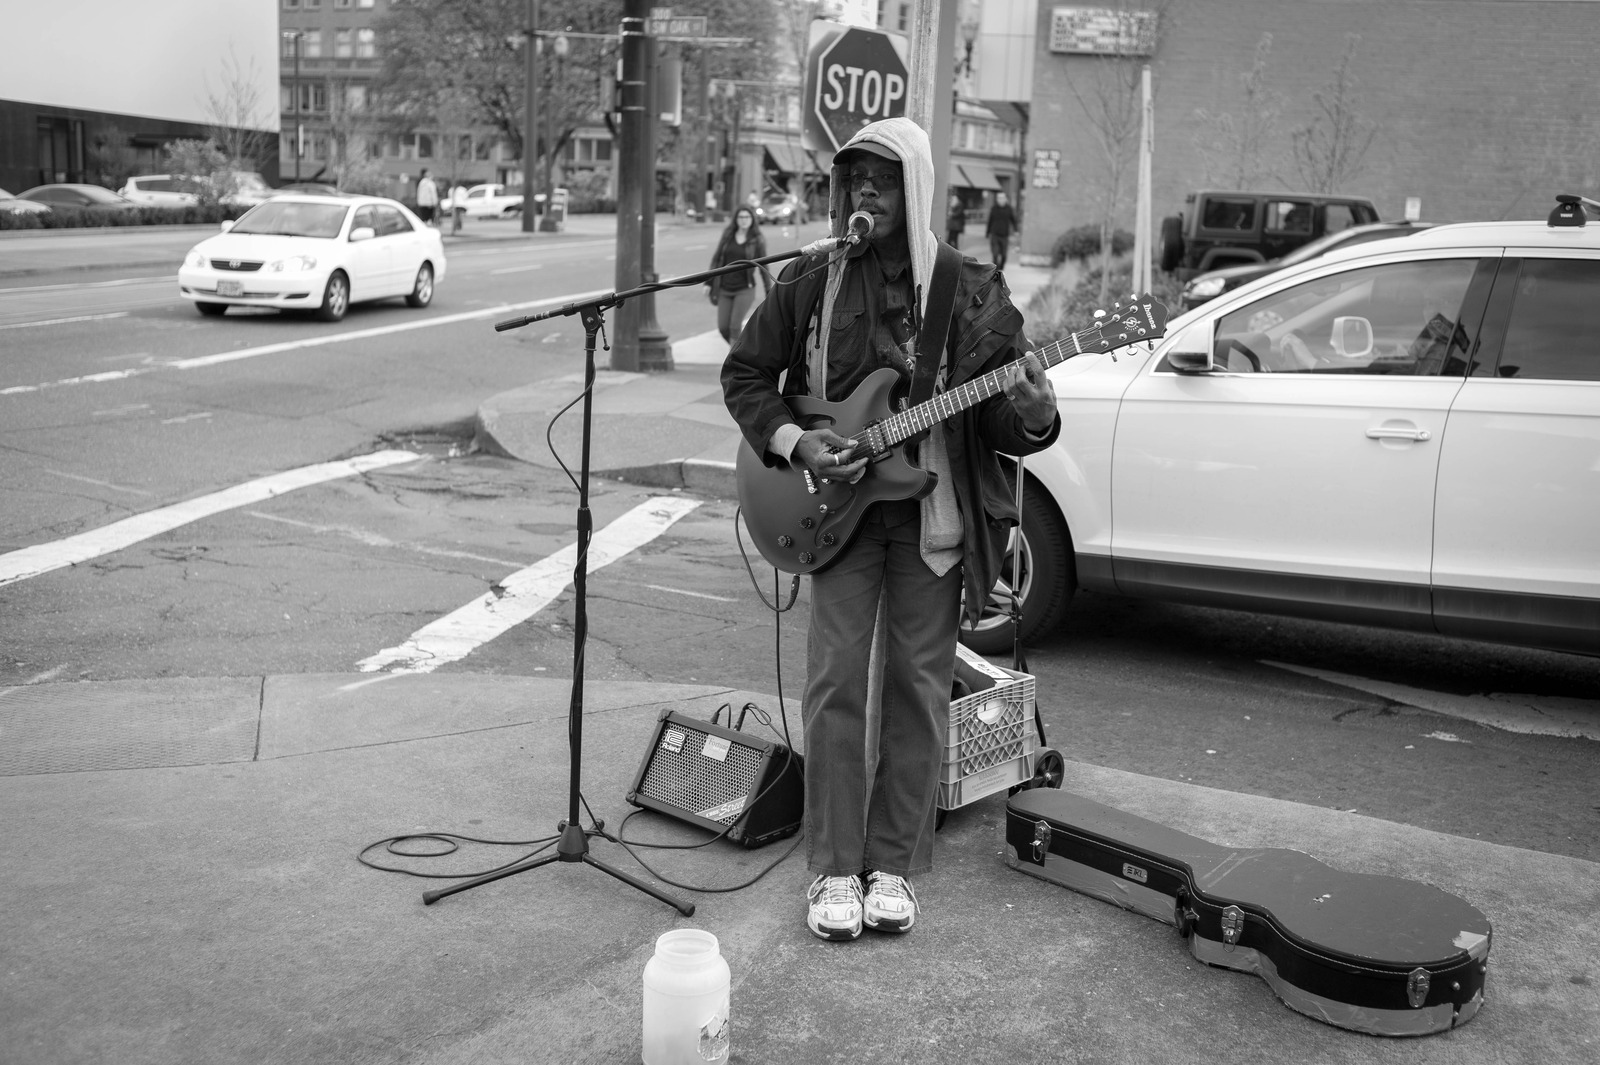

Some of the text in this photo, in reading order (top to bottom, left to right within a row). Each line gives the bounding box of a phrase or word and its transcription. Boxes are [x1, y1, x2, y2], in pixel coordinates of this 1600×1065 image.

[652, 20, 667, 34] SW
[670, 20, 690, 34] OAK
[823, 63, 905, 118] STOP
[1142, 303, 1157, 330] Ibanez
[662, 742, 682, 754] Roland
[718, 799, 745, 816] Street
